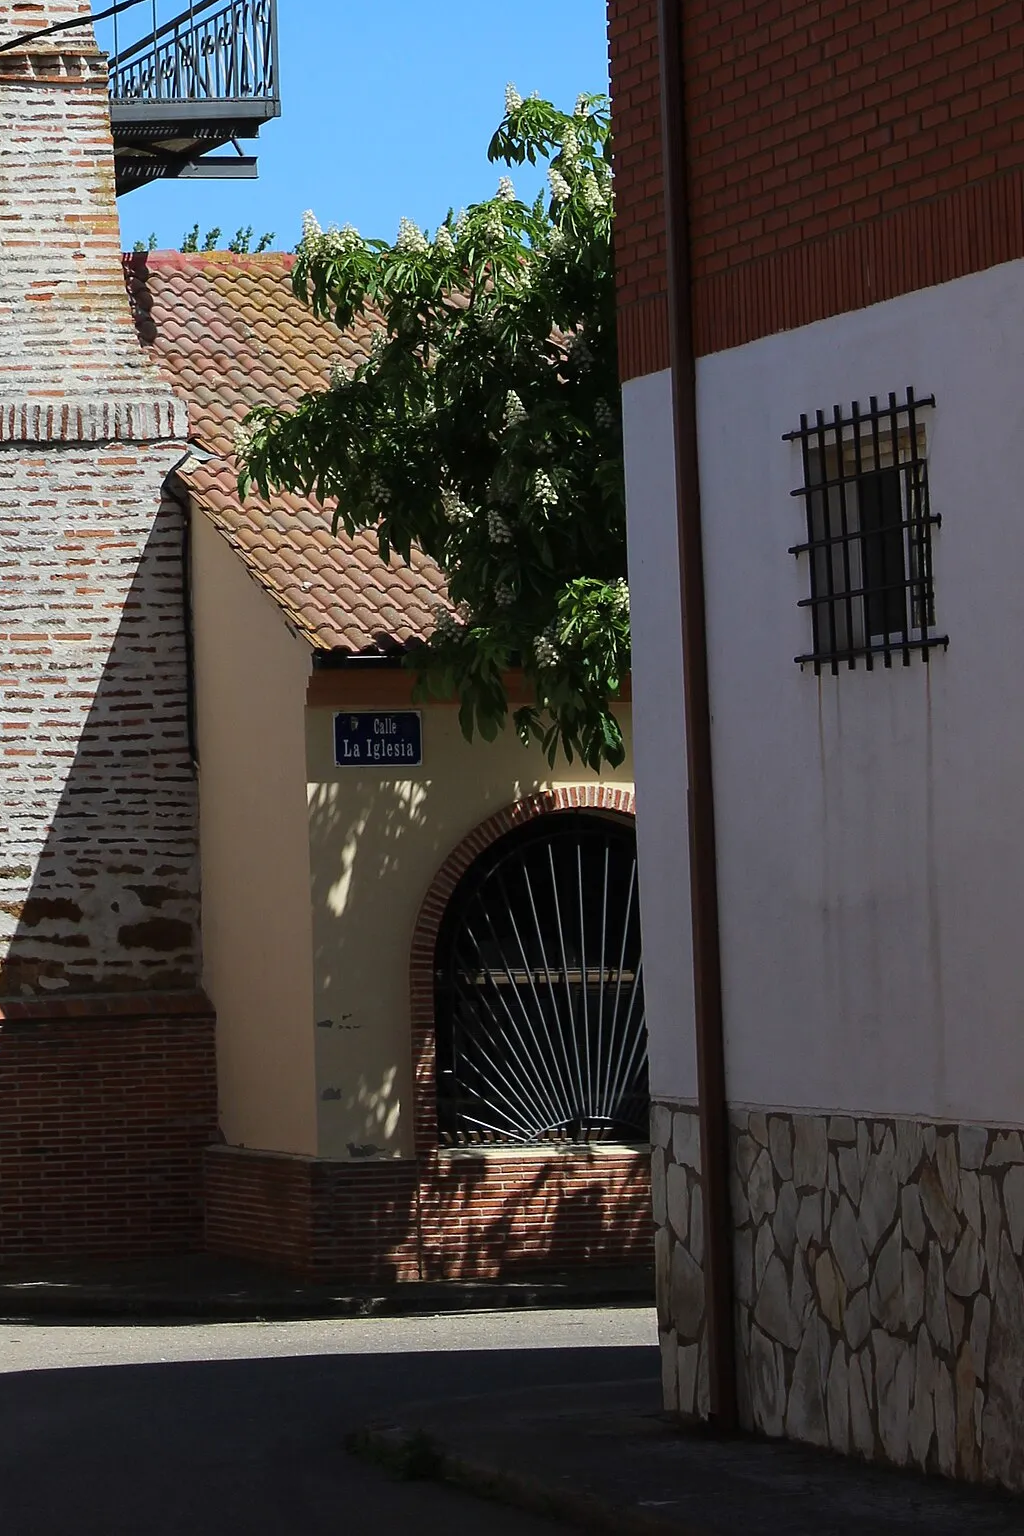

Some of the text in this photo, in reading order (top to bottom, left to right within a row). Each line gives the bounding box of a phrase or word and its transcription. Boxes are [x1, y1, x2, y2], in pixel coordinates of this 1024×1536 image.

[373, 718, 397, 734] Calle
[343, 738, 413, 760] La Iglesia
